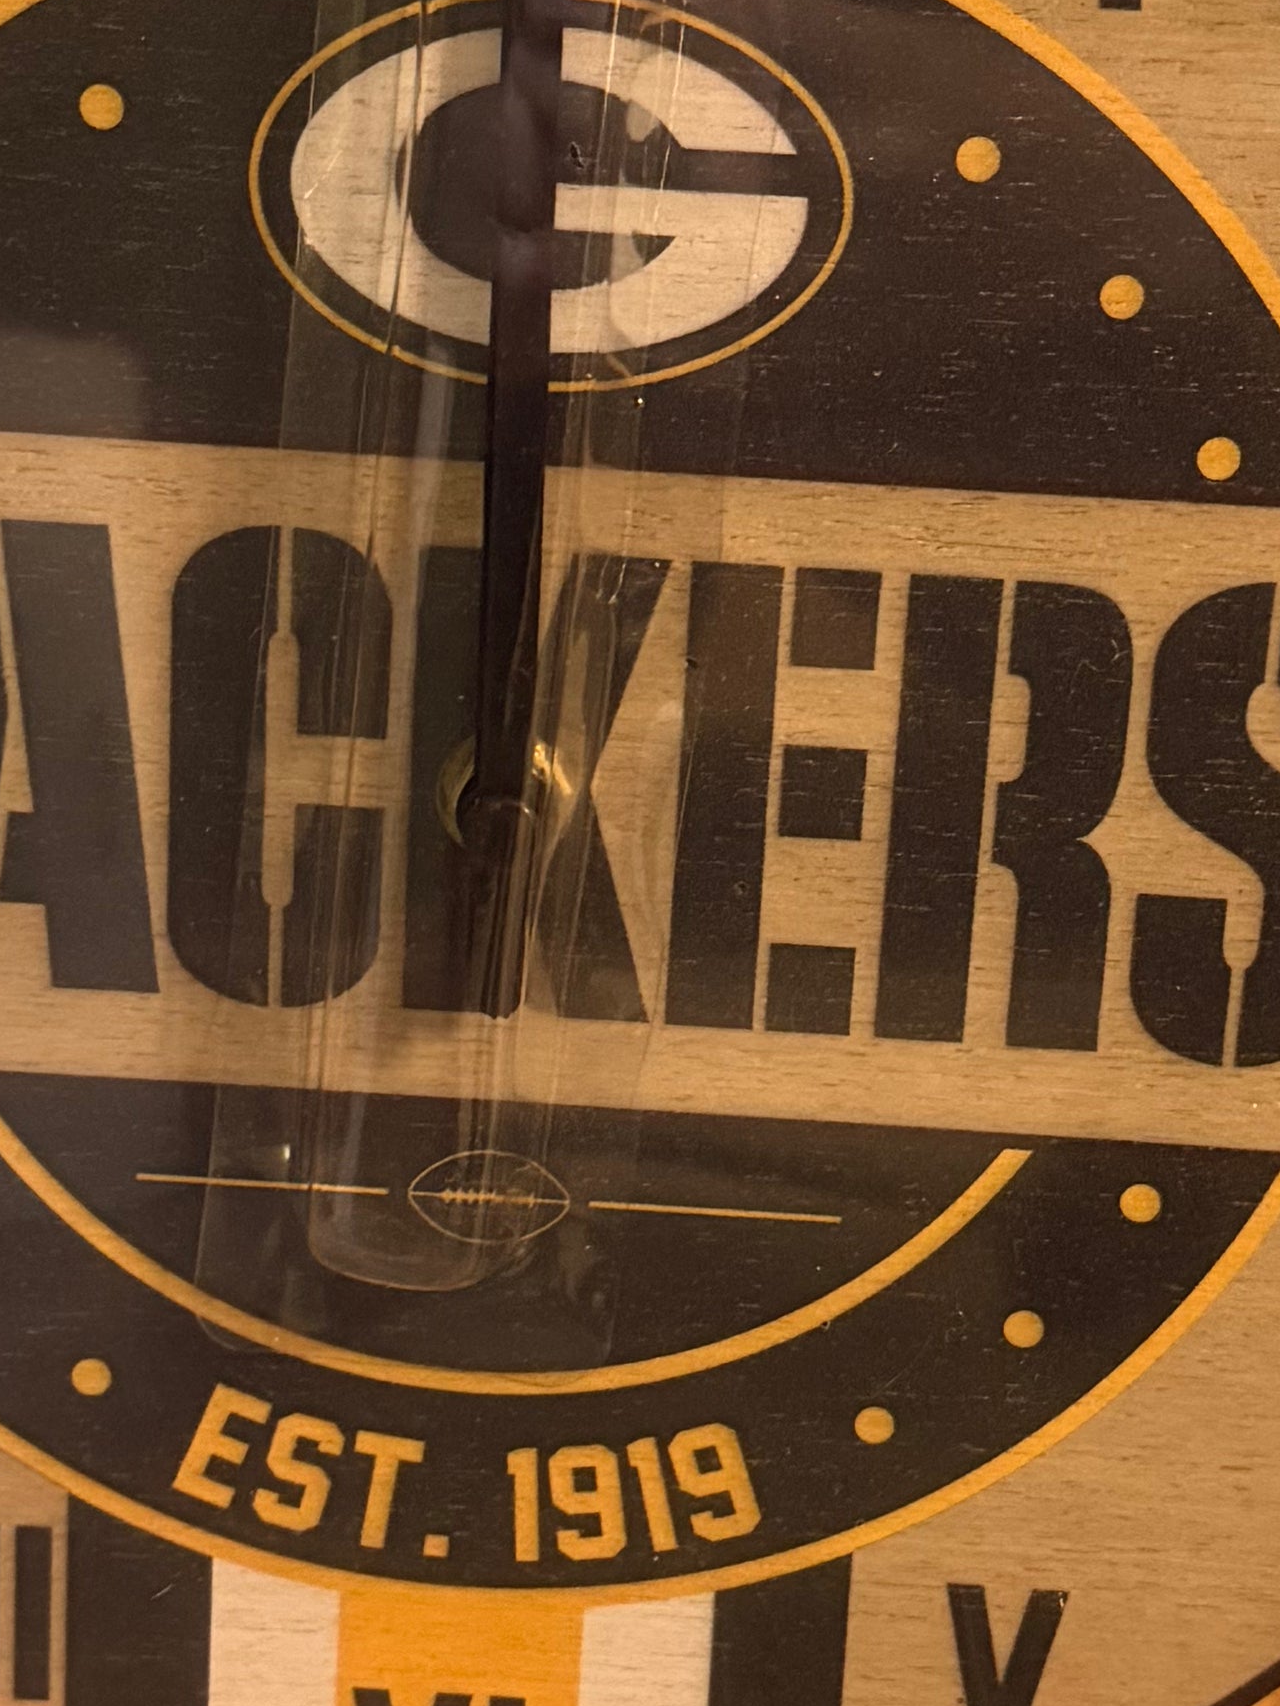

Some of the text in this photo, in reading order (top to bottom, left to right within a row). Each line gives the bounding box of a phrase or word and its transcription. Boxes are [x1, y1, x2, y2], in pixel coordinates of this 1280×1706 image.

[290, 25, 809, 354] G
[171, 1382, 761, 1562] EST. 1919
